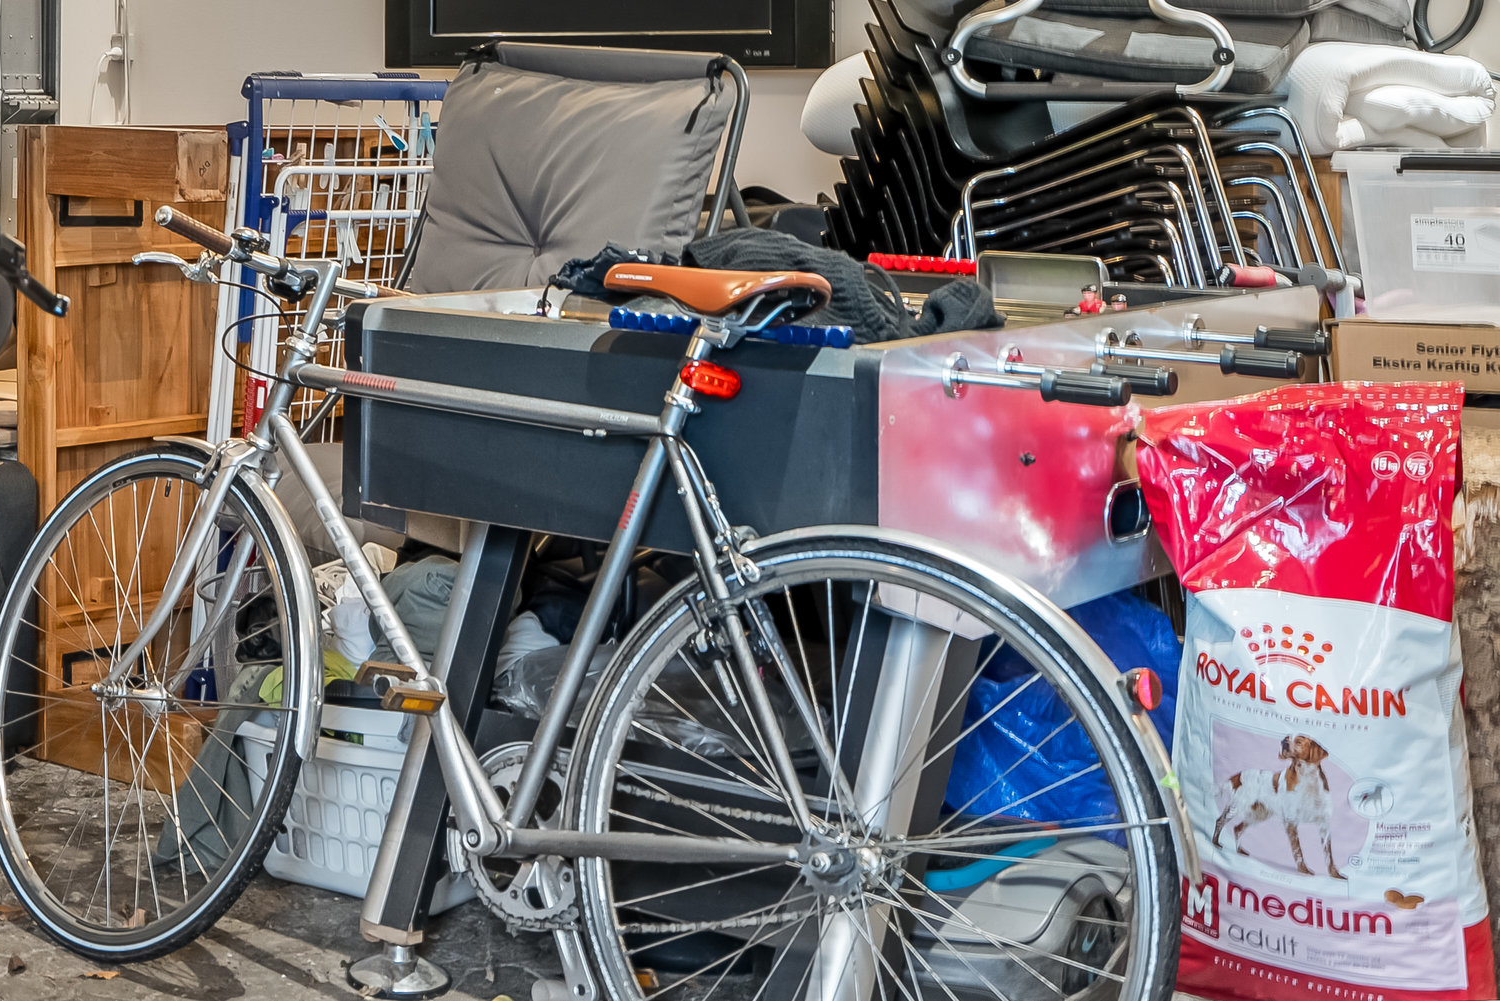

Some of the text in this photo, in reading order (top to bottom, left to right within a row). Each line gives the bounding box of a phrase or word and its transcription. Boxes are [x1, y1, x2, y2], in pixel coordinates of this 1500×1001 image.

[1444, 232, 1466, 249] 40
[1416, 341, 1466, 356] Senior
[1372, 356, 1421, 371] Ekstra
[1427, 358, 1480, 375] Kraftig
[1196, 652, 1406, 717] ROYAL CANIN
[1187, 884, 1213, 928] M
[1227, 882, 1393, 936] medium
[1228, 923, 1299, 957] adult
